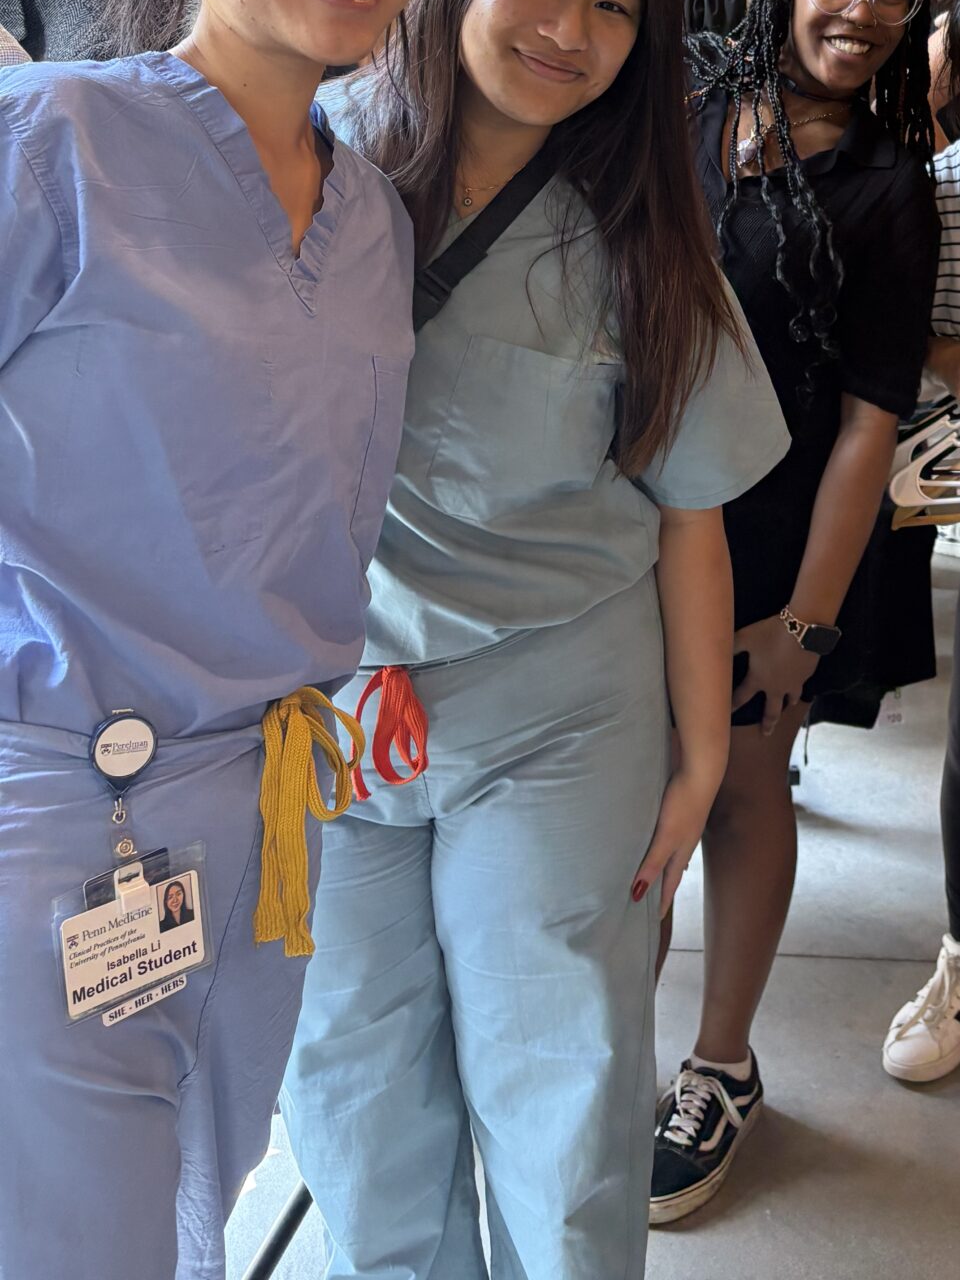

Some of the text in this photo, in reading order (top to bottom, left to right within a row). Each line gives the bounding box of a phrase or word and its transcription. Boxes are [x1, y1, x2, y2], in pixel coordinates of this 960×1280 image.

[82, 907, 153, 941] Penn Medicine
[69, 928, 137, 961] Clinical Practices of the
[70, 933, 146, 969] University of Pennsylvania
[106, 939, 161, 972] Isabella Li
[72, 940, 198, 1005] Medical Student
[108, 977, 185, 1022] SHE HER HERS
